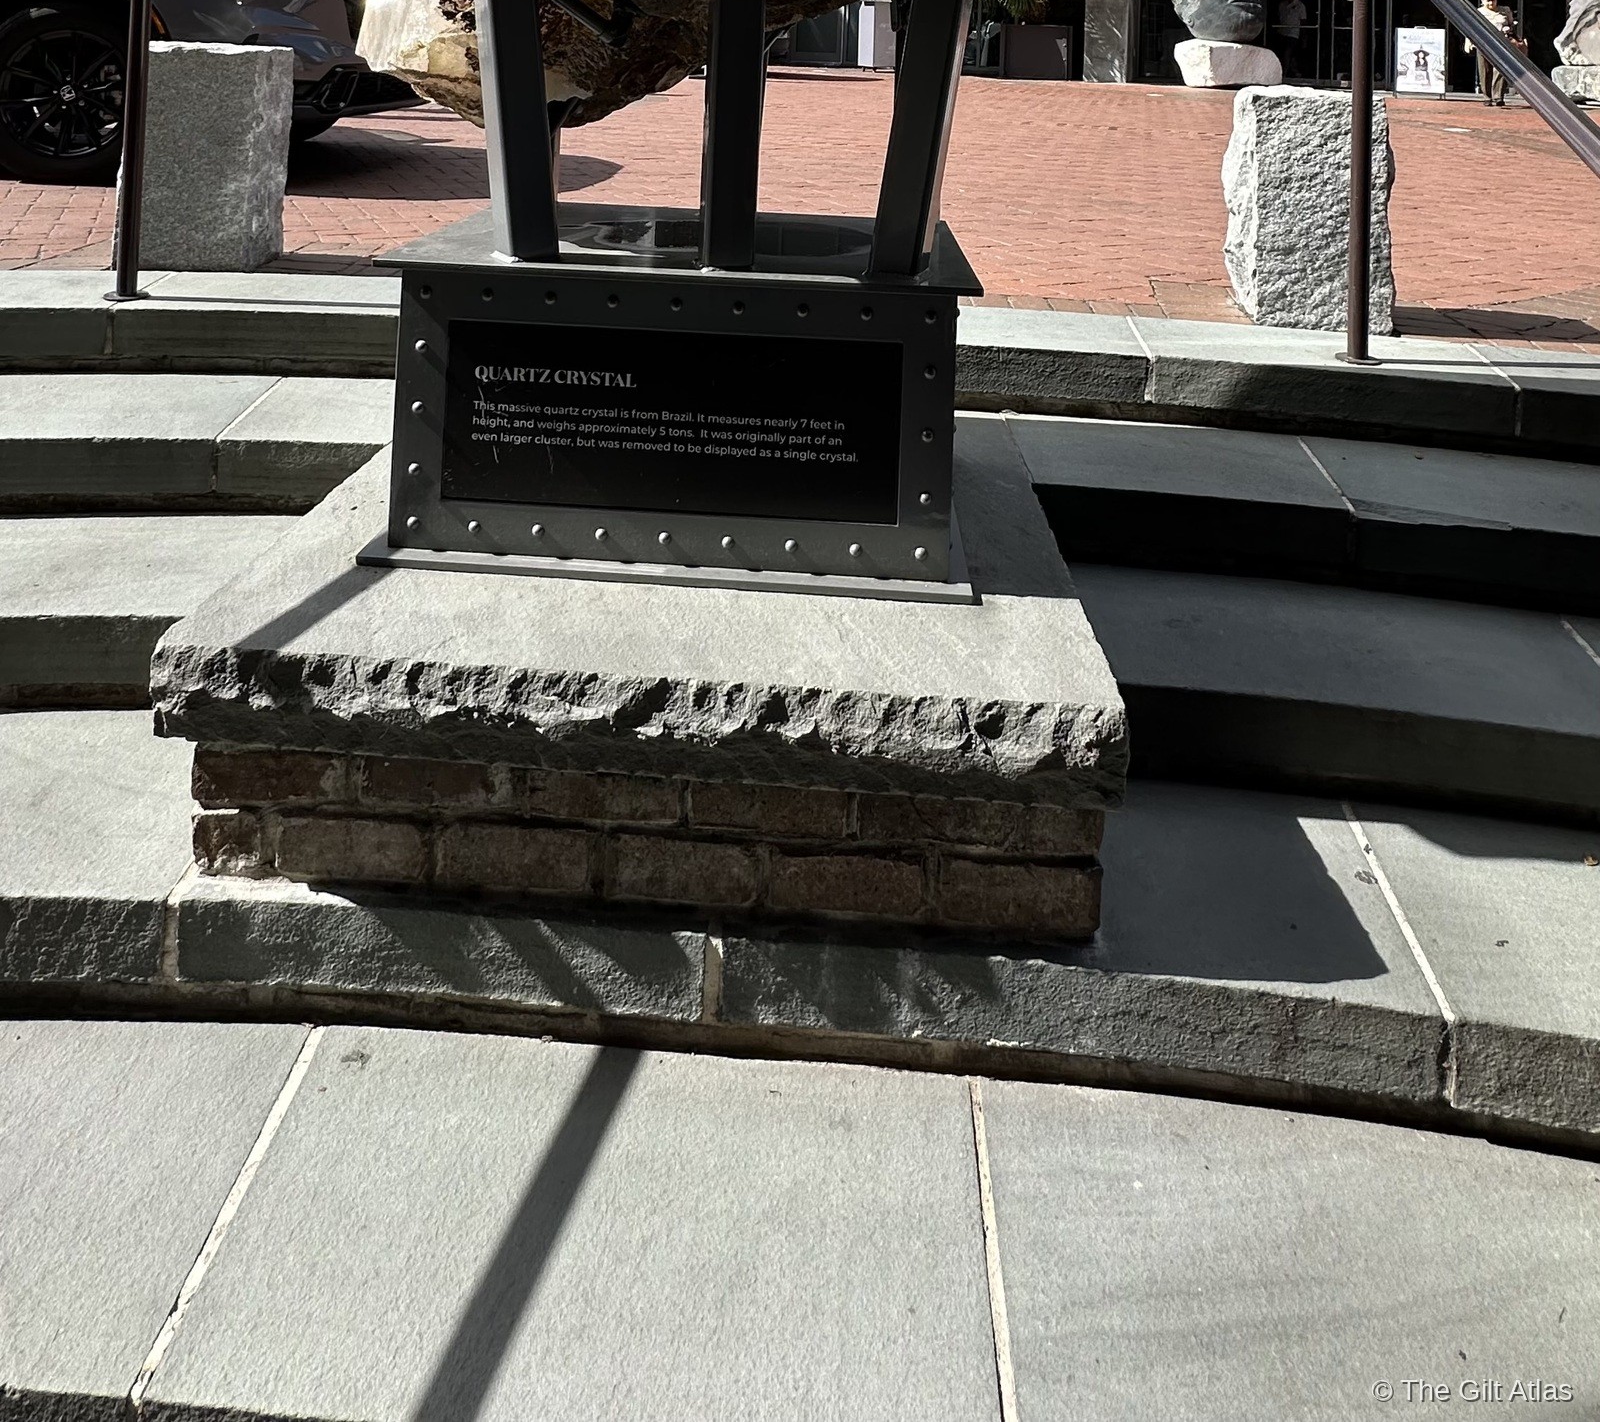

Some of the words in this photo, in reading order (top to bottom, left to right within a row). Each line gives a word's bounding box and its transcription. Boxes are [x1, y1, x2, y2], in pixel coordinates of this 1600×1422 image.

[475, 365, 551, 383] QUARTZ
[554, 370, 637, 388] CRYSTAL
[473, 401, 495, 411] This
[498, 403, 541, 413] massive
[544, 406, 578, 416] quartz
[582, 408, 618, 418] crystal
[621, 409, 629, 418] is
[631, 410, 658, 420] from
[662, 411, 694, 422] Brazil.
[698, 413, 705, 423] It
[708, 415, 761, 426] measures
[764, 418, 798, 429] nearly
[801, 419, 807, 428] 7
[810, 419, 832, 429] feet
[834, 421, 845, 430] in
[472, 416, 511, 428] height,
[513, 417, 534, 428] and
[537, 420, 576, 431] weighs
[578, 423, 657, 437] approximately
[659, 427, 666, 435] 5
[669, 428, 695, 438] tons.
[700, 429, 708, 438] It
[711, 431, 732, 439] was
[735, 431, 786, 444] originally
[789, 435, 811, 444] part
[815, 435, 825, 444] of
[828, 436, 842, 445] an
[471, 433, 498, 442] even
[500, 433, 532, 444] larger
[535, 435, 574, 447] cluster,
[577, 437, 595, 447] but
[598, 440, 620, 448] was
[622, 440, 671, 451] removed
[674, 442, 685, 452] to
[687, 444, 701, 453] be
[704, 444, 757, 457] displayed
[759, 449, 771, 457] as
[783, 450, 817, 461] single
[820, 452, 858, 463] crystal.
